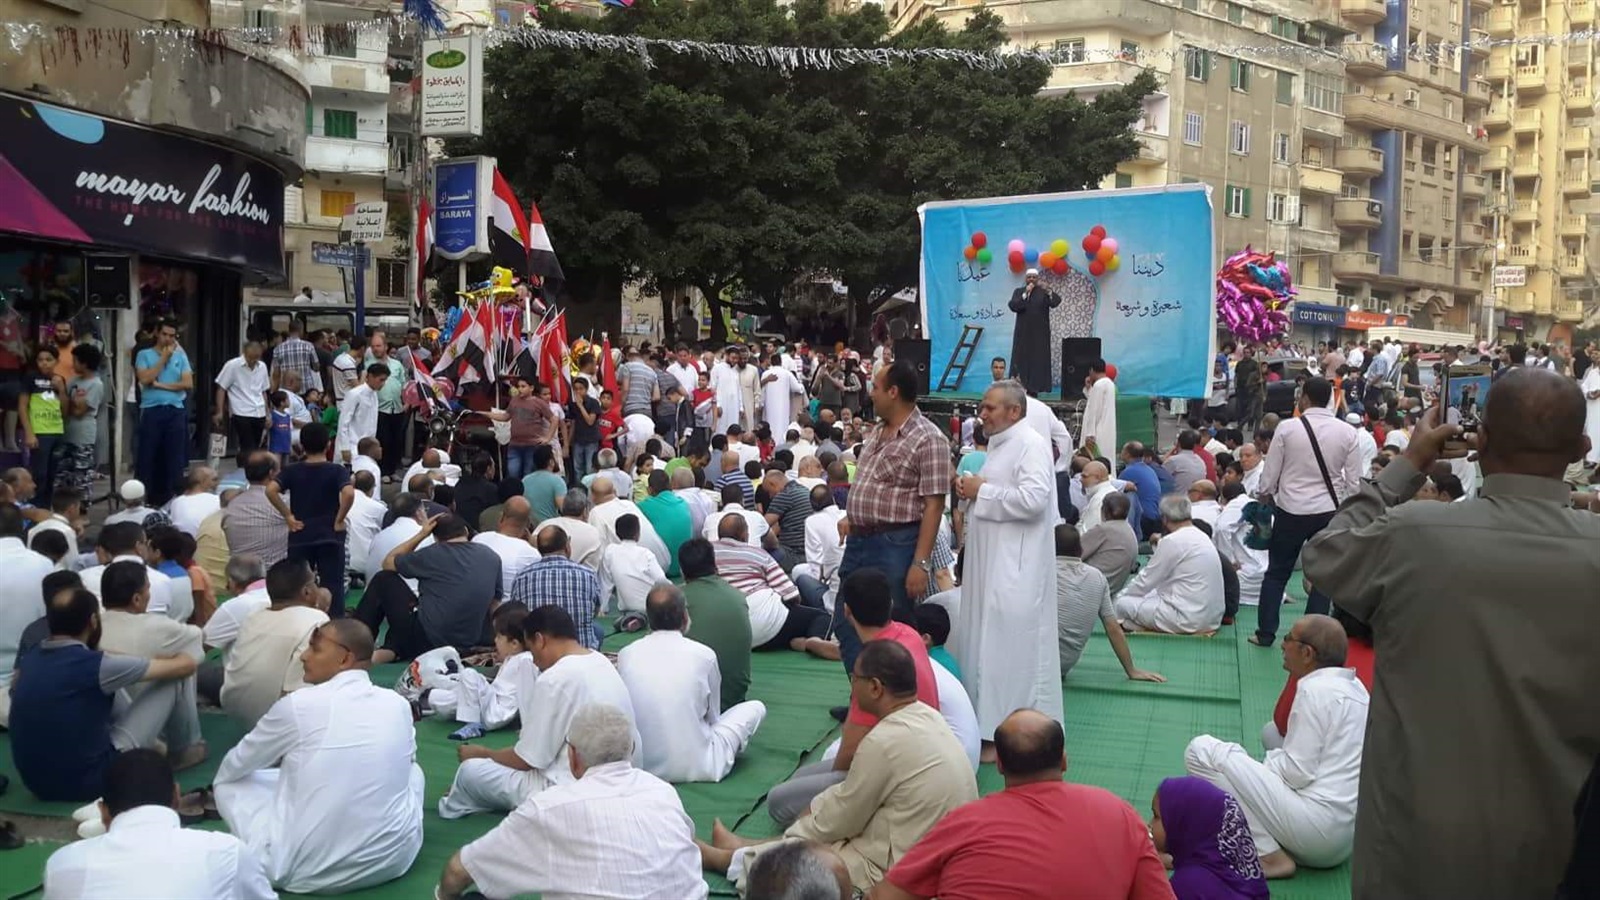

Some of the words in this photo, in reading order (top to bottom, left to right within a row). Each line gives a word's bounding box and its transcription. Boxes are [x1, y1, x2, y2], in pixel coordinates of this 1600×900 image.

[75, 170, 186, 226] mayar
[188, 163, 270, 225] fashion
[440, 209, 472, 219] SARAYA
[1132, 254, 1164, 278] ديننا
[1299, 310, 1334, 323] COTTONIL
